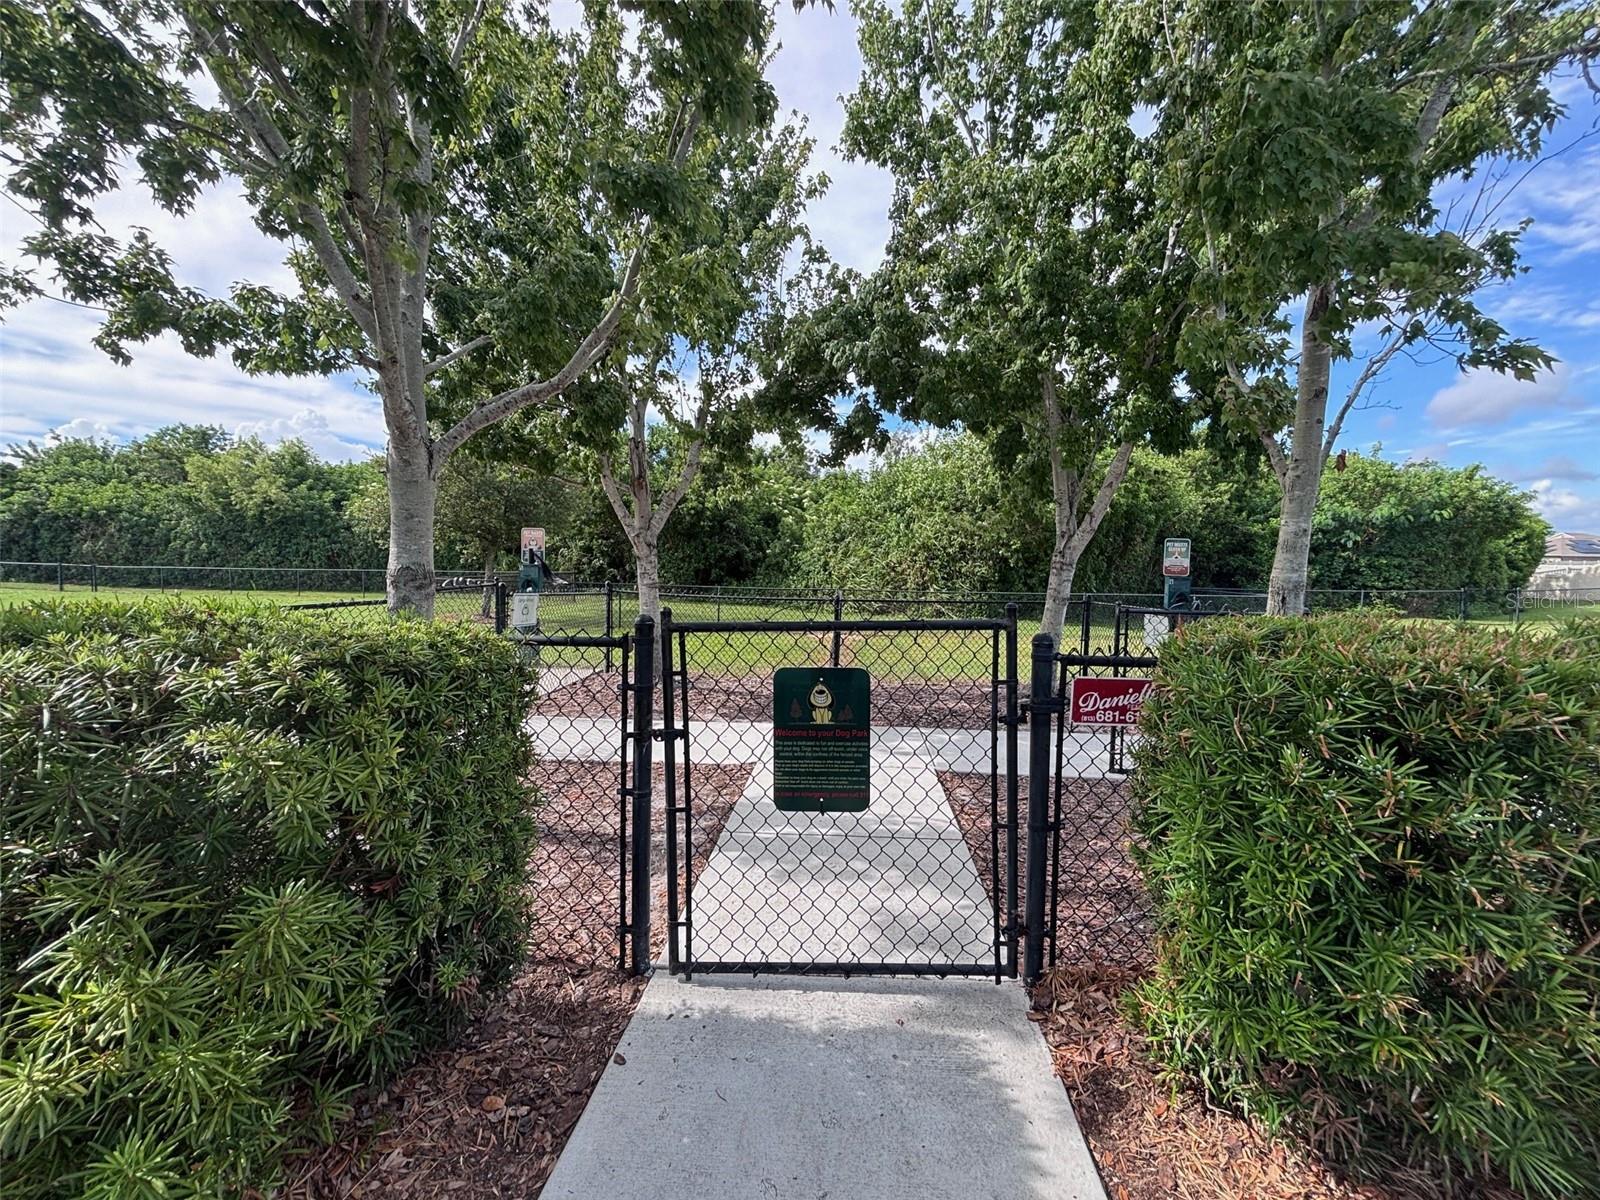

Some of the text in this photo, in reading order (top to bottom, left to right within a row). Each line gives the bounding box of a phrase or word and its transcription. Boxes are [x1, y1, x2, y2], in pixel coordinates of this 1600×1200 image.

[775, 728, 868, 739] Welcome to your Dog Park
